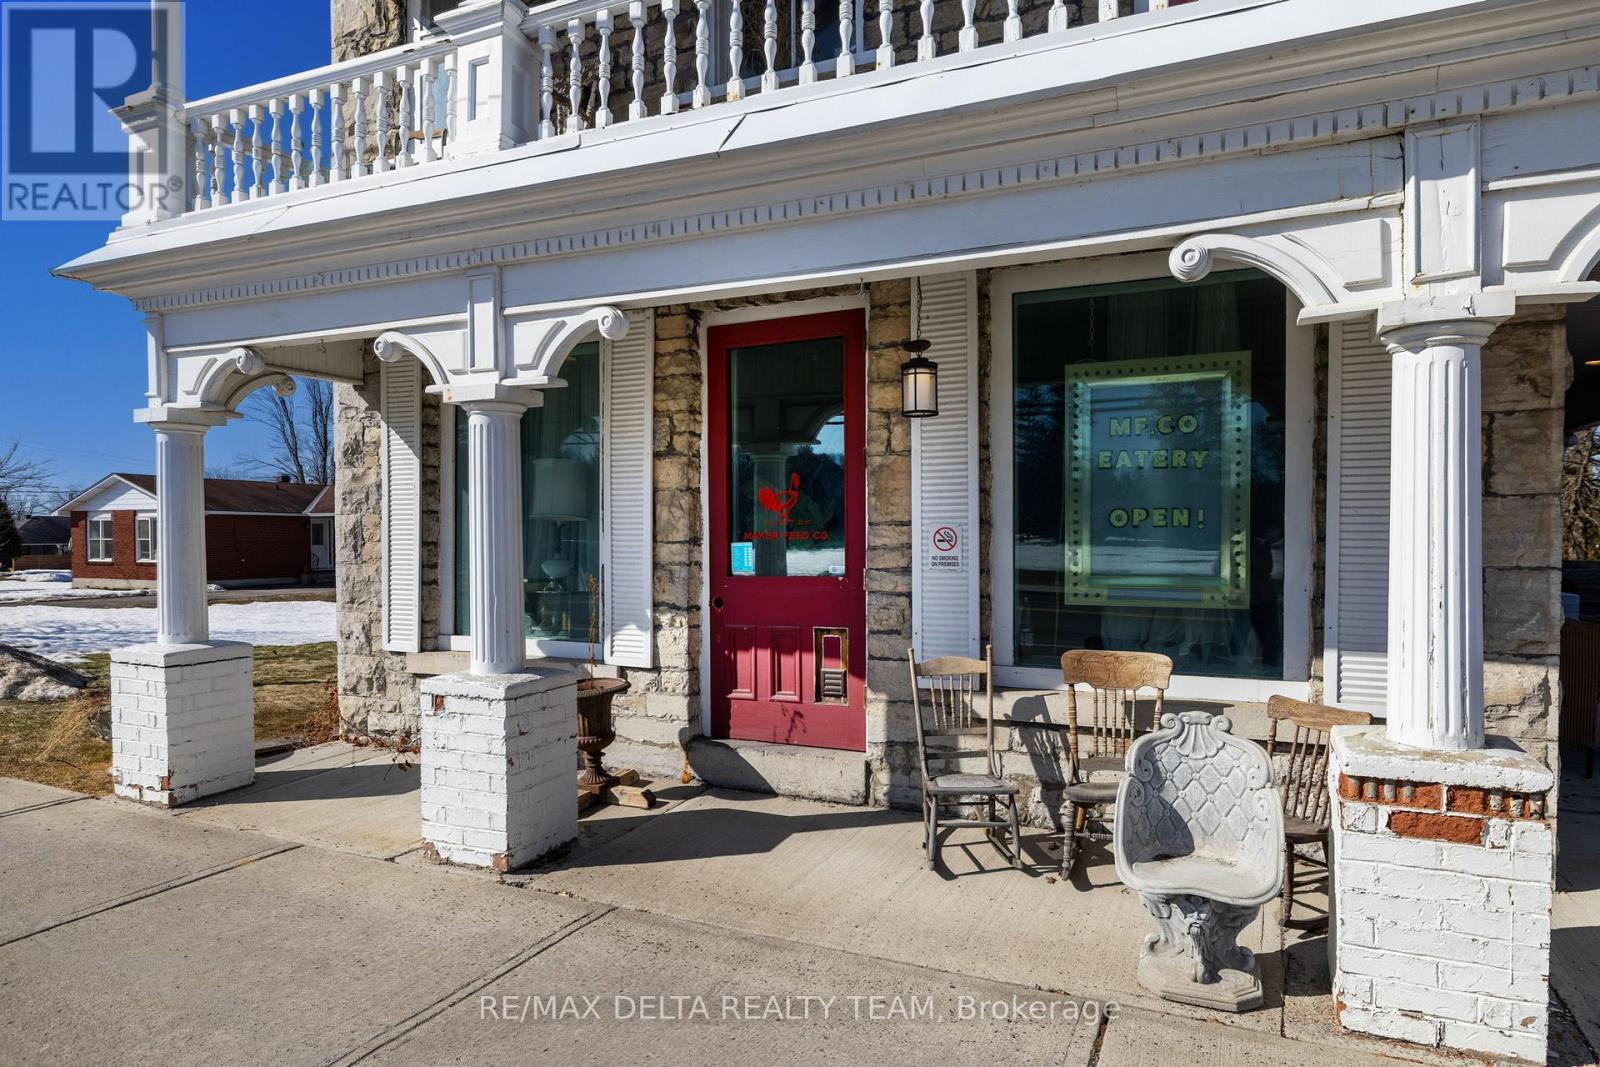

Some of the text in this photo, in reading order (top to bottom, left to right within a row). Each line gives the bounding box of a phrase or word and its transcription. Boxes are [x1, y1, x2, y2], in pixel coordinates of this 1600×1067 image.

[1097, 448, 1210, 469] EATERY
[1108, 507, 1206, 529] OPEN!
[744, 531, 780, 540] MAKER
[784, 531, 809, 540] FEED
